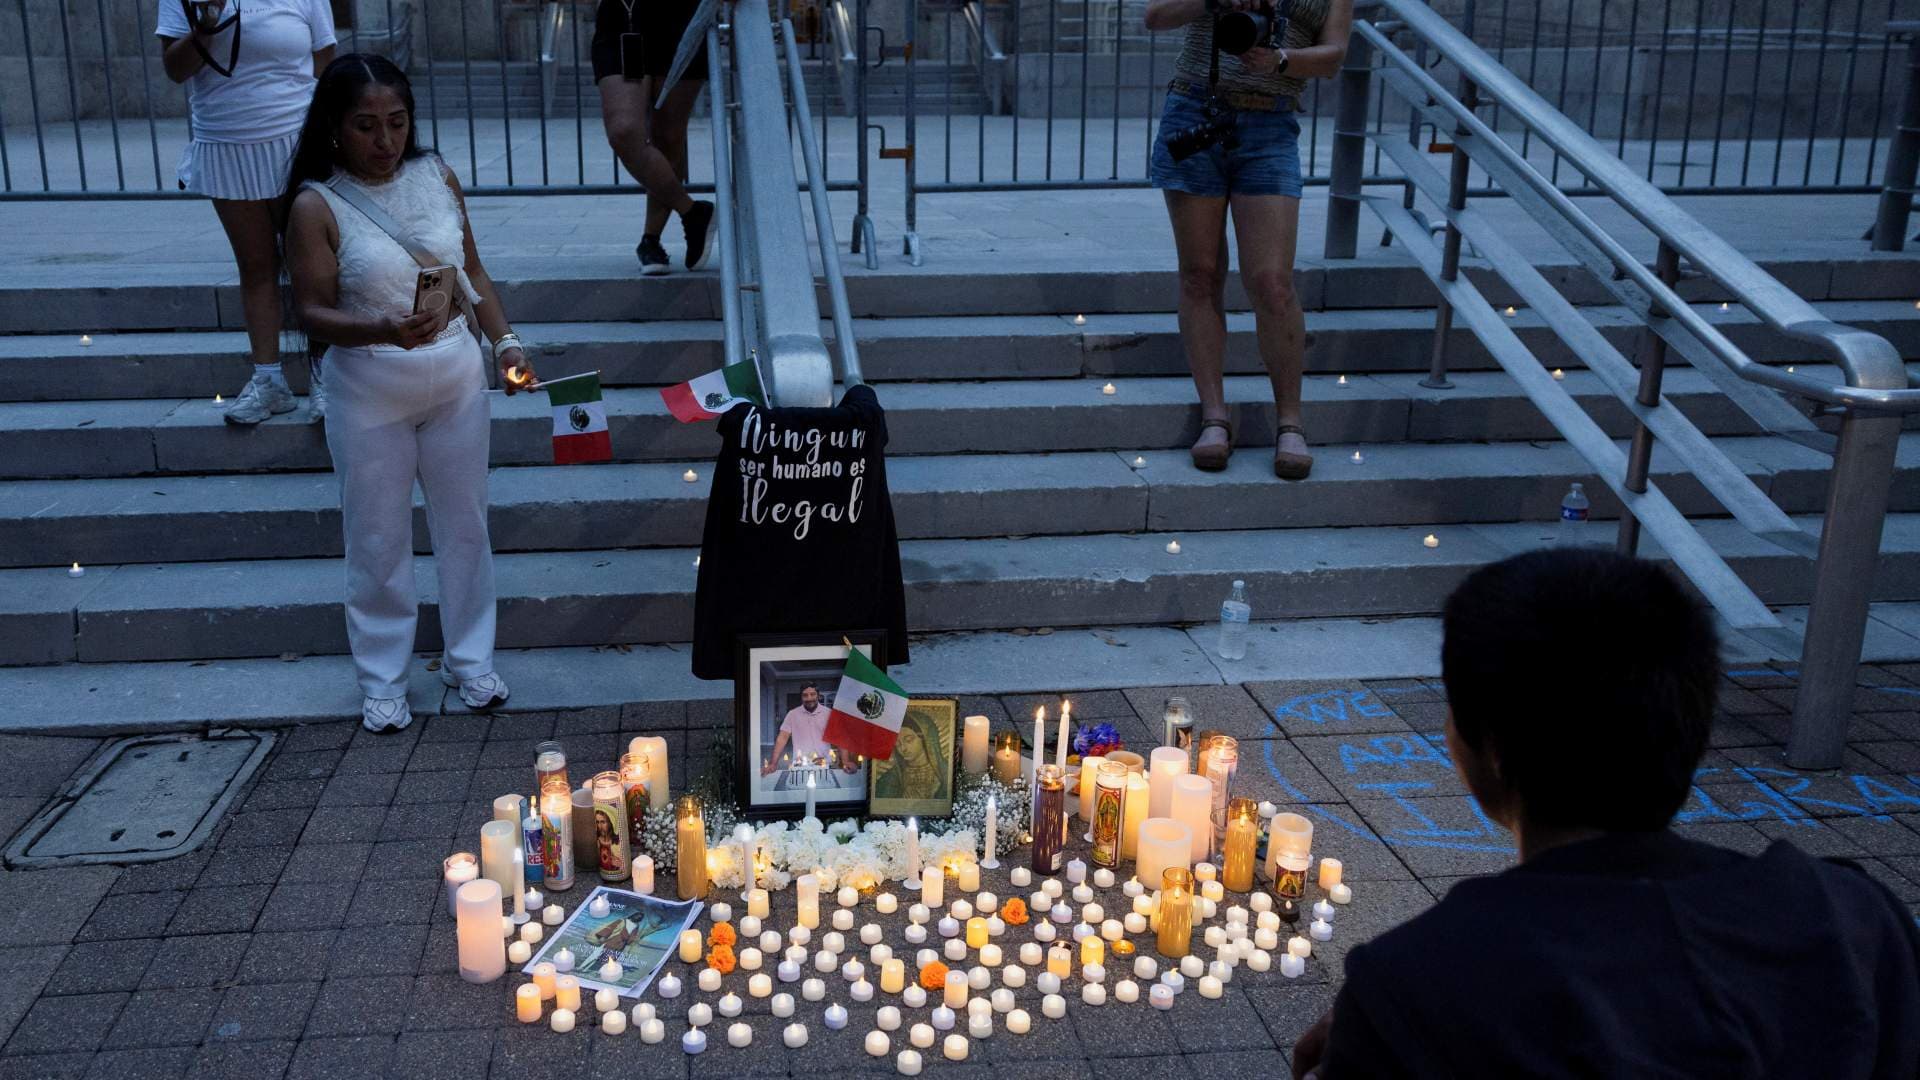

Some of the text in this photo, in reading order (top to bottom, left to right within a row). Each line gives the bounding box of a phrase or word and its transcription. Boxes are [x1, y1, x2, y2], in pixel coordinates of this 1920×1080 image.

[741, 406, 866, 464] Ningun
[739, 455, 866, 479] ser humano es
[739, 475, 864, 541] Ilegal
